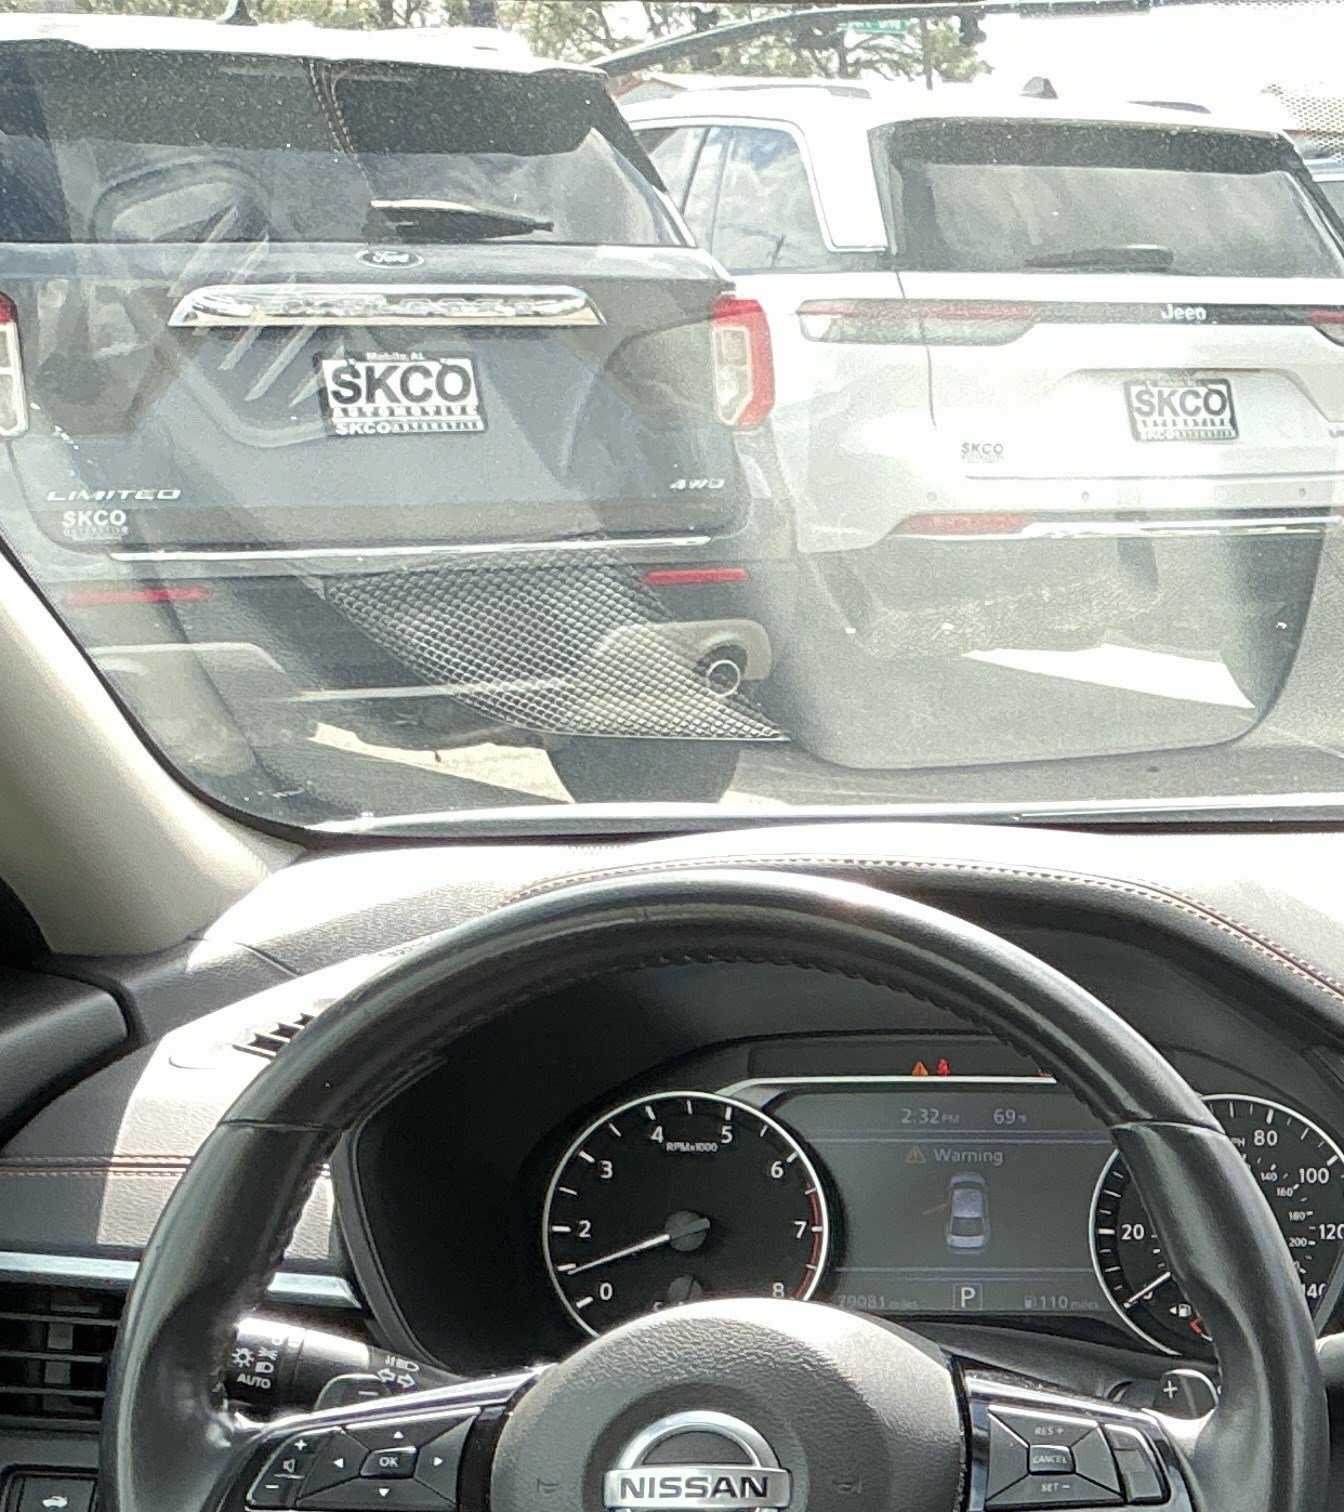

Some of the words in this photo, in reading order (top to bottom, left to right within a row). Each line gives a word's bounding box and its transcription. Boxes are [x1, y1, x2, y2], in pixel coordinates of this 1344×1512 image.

[1161, 303, 1206, 321] Jeep
[331, 364, 472, 404] SKCO
[1134, 389, 1228, 417] SKCO
[335, 422, 392, 435] SKCO
[961, 442, 1004, 455] SKCO
[47, 489, 182, 501] LIMITED
[62, 510, 127, 526] SKCO
[901, 1108, 939, 1124] 2:32
[993, 1108, 1016, 1124] 69
[650, 1126, 664, 1143] 4
[721, 1125, 733, 1143] 5
[1254, 1129, 1278, 1146] 80
[933, 1148, 1003, 1167] Warning
[600, 1161, 613, 1179] 3
[771, 1161, 784, 1179] 6
[1299, 1167, 1330, 1184] 100
[578, 1220, 591, 1239] 2
[793, 1220, 807, 1239] 7
[1122, 1223, 1145, 1240] 20
[1289, 1237, 1307, 1247] 200
[600, 1282, 613, 1301] 0
[772, 1282, 785, 1298] 8
[960, 1287, 975, 1309] P
[1040, 1295, 1069, 1309] 110
[236, 1373, 271, 1390] AUTO
[1034, 1426, 1055, 1436] RES
[379, 1457, 398, 1467] OK
[620, 1476, 768, 1499] NISSAN
